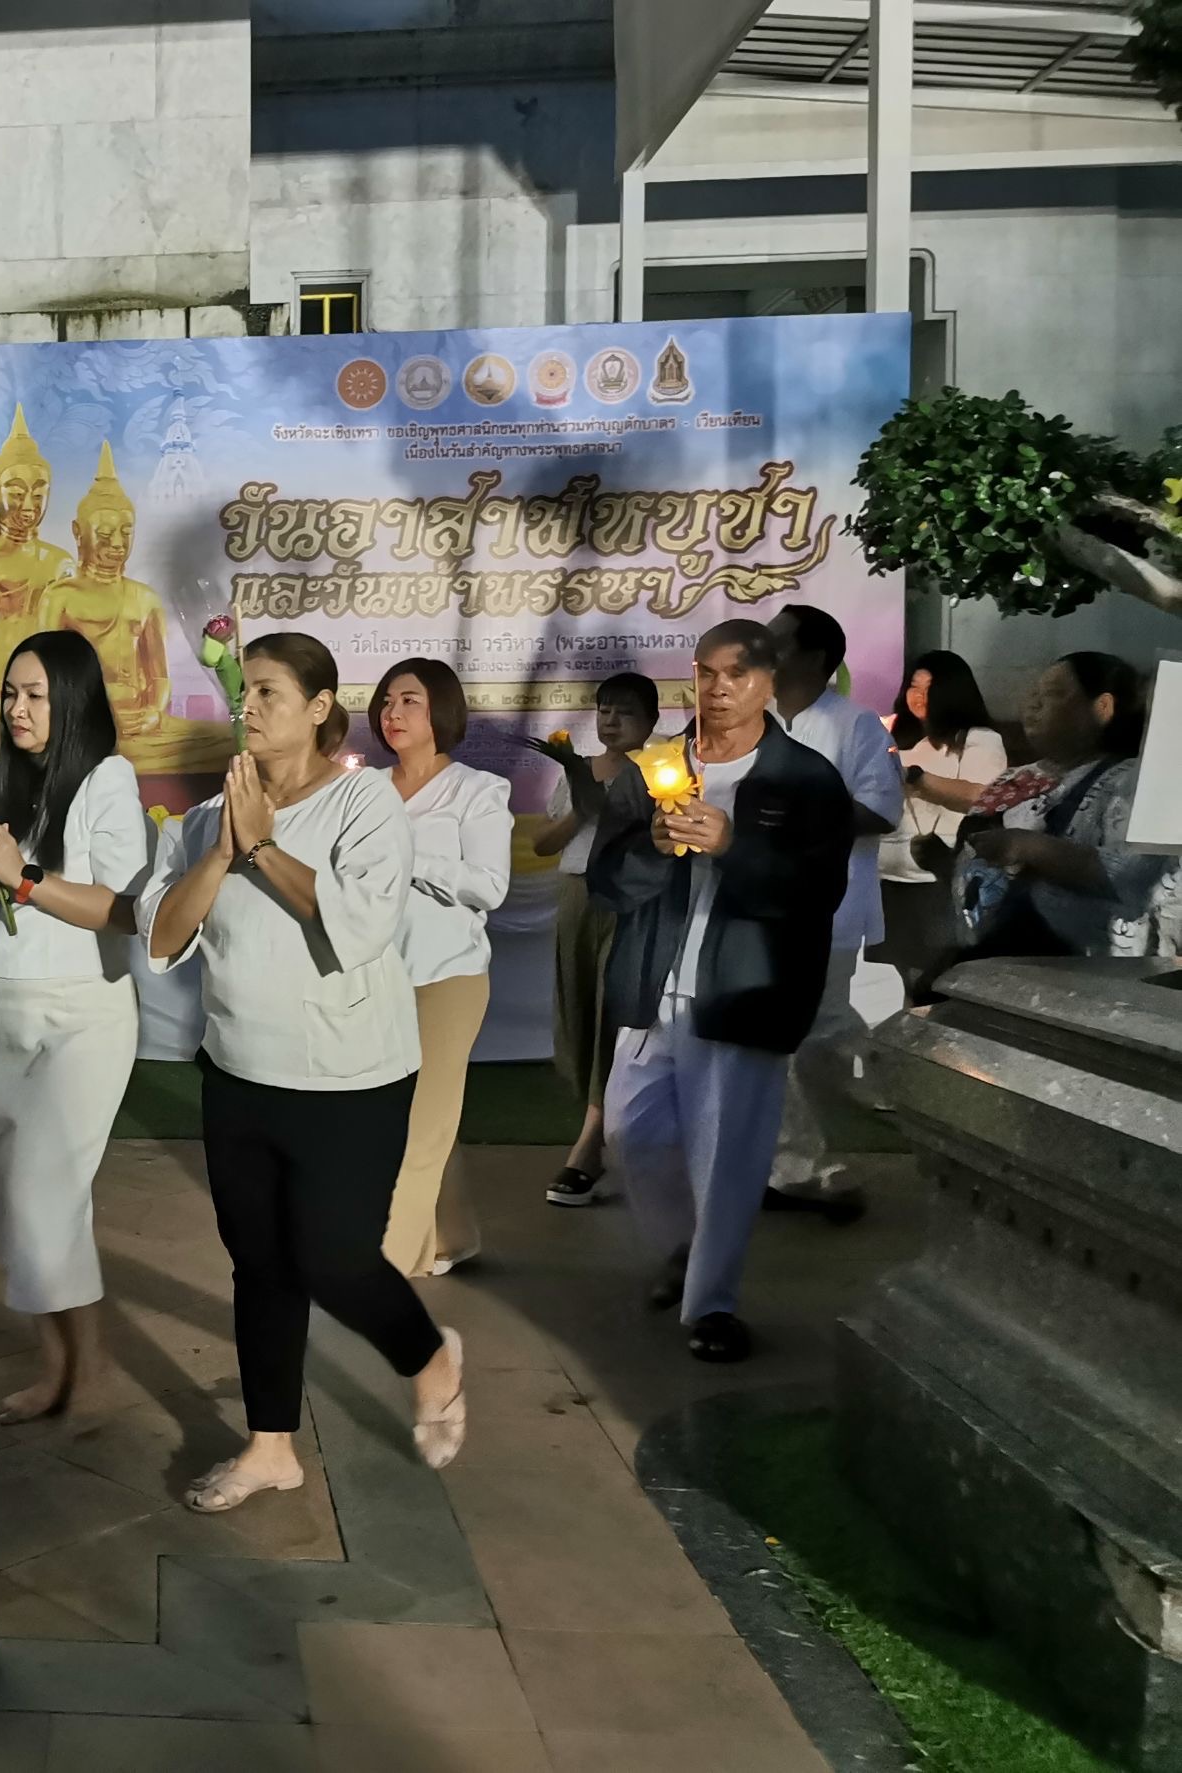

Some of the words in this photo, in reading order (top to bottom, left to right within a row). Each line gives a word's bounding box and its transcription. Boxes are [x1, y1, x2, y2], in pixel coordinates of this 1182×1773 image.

[273, 424, 379, 440] จังหวัดฉะเชิงเทรา
[696, 411, 762, 428] เวียนเทียน
[351, 630, 471, 654] วัดโสธรวราราม
[483, 632, 545, 652] วรวิหาร
